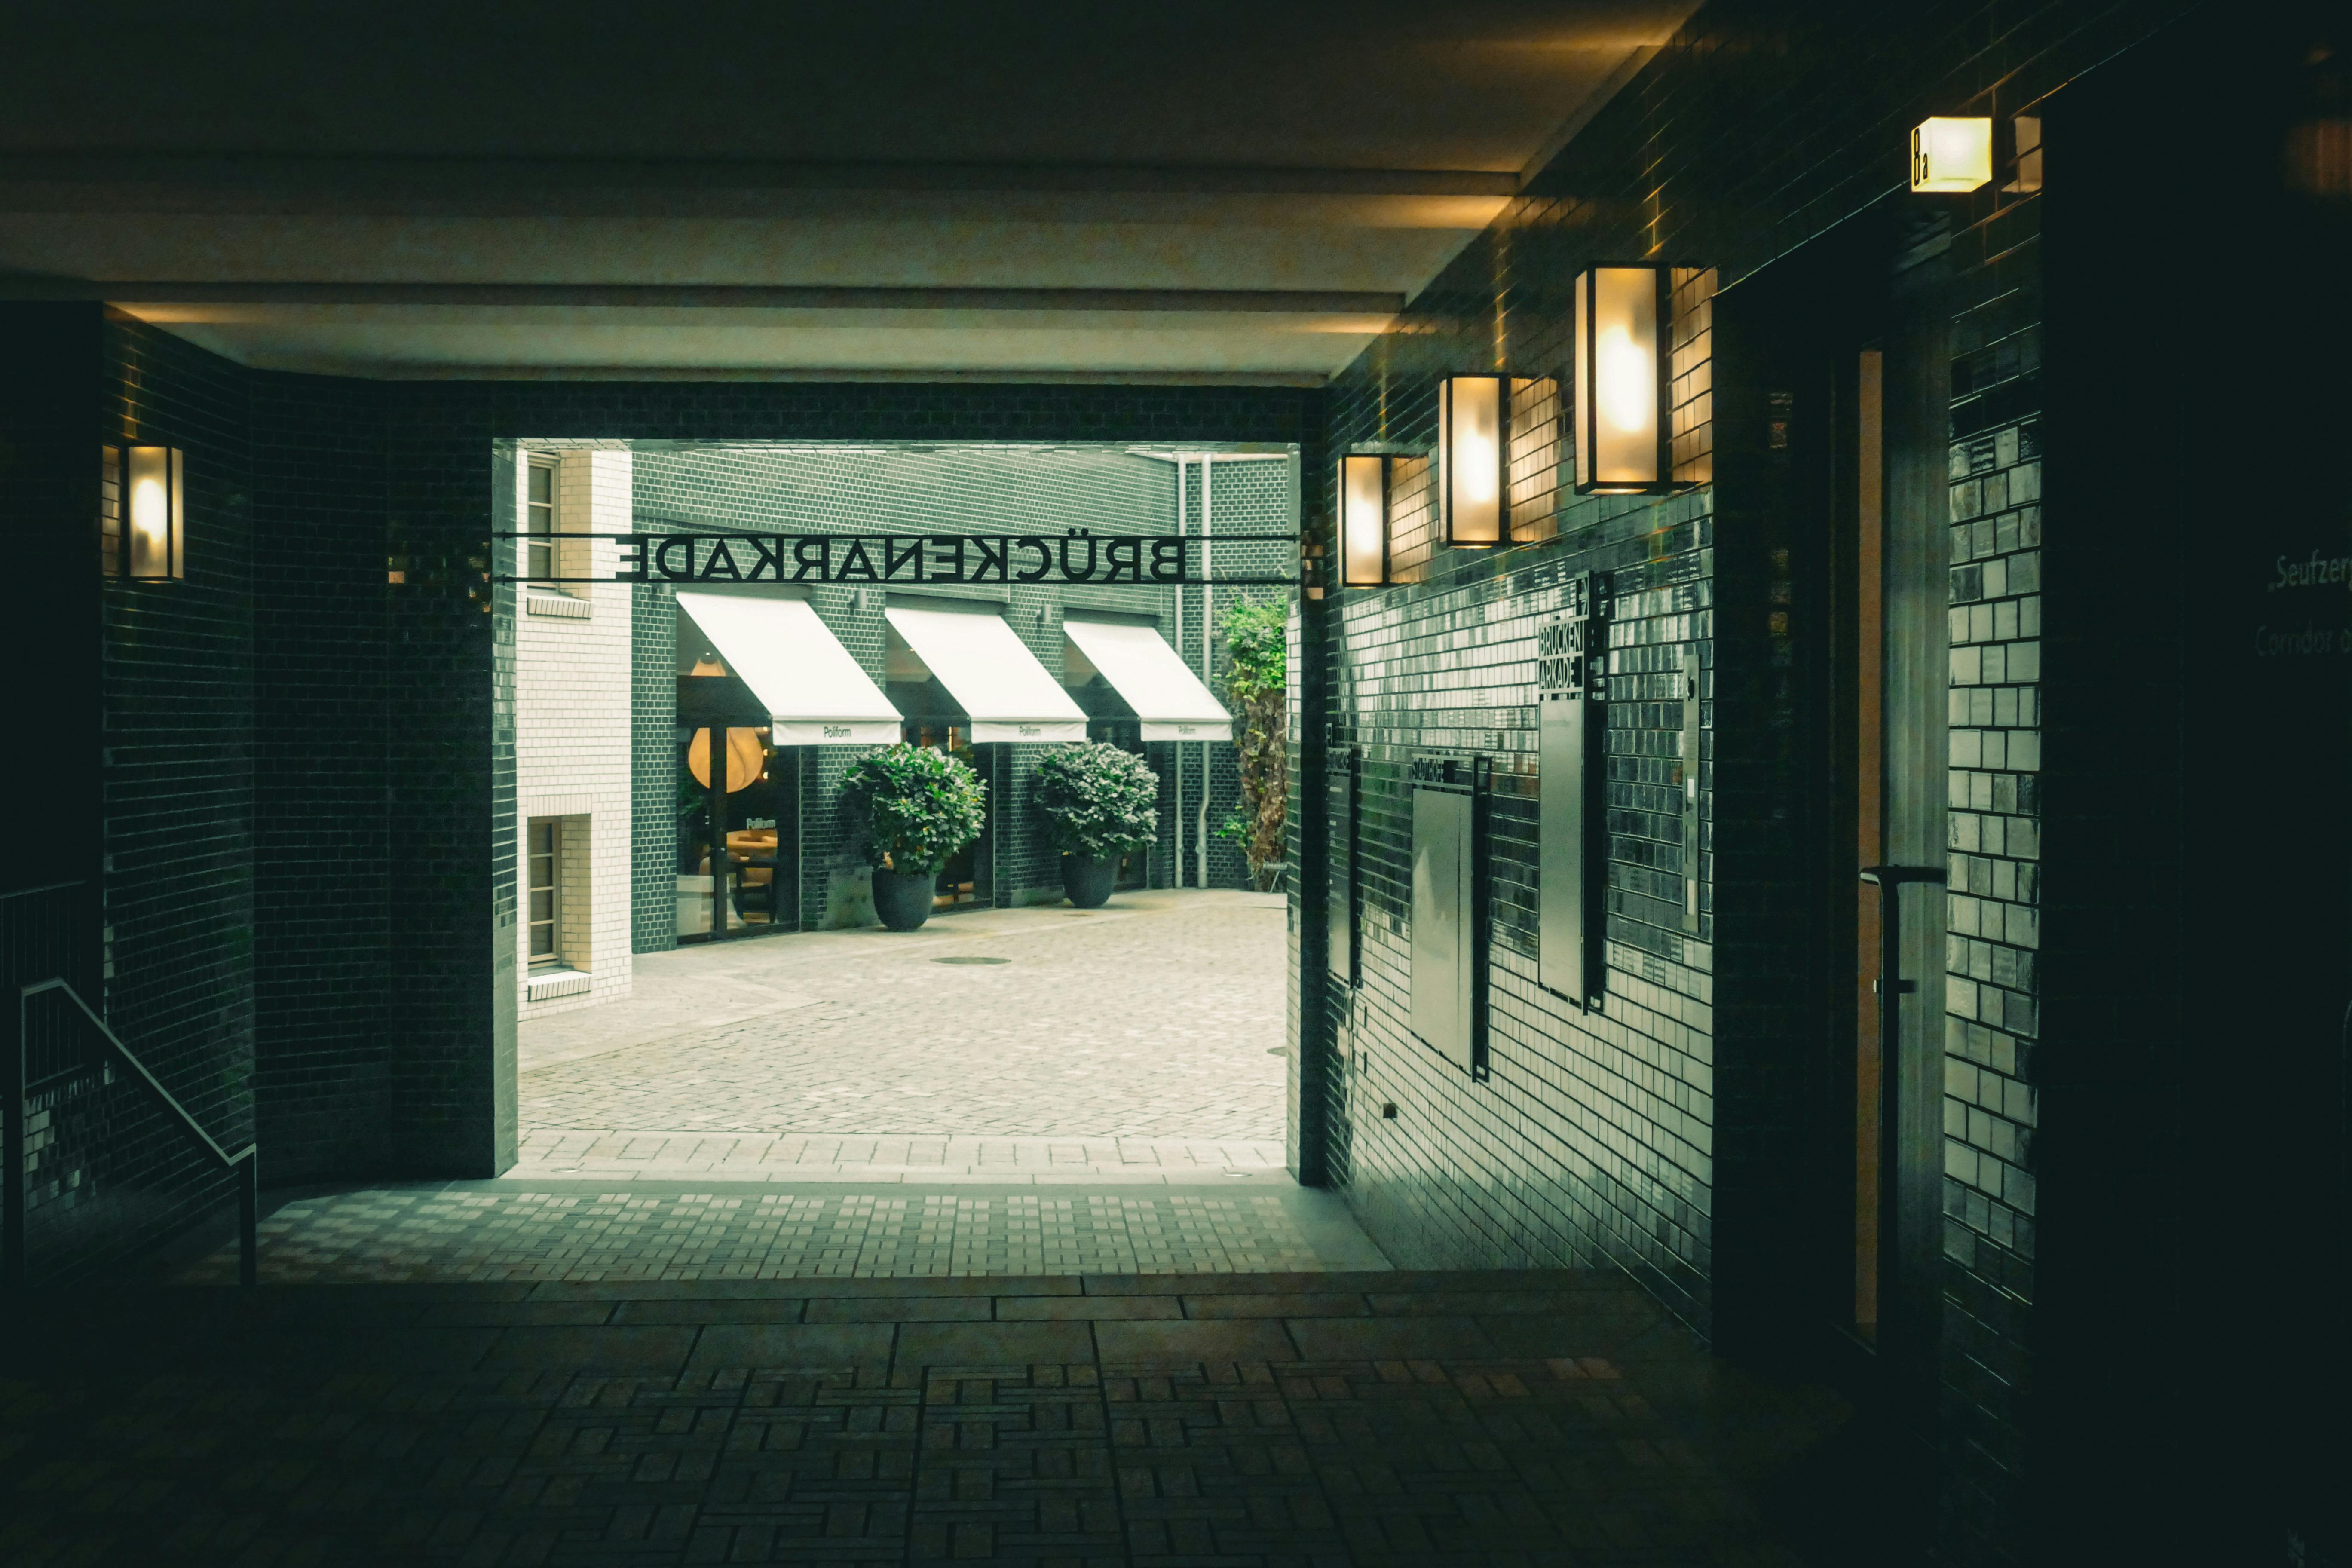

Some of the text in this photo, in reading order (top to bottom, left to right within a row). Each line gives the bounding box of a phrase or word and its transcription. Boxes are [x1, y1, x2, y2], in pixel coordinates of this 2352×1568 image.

[1914, 128, 1928, 186] 8a
[2267, 549, 2352, 592] „Seufzer
[2256, 619, 2334, 657] Corridor
[1540, 656, 1575, 690] ARKADE
[824, 726, 851, 738] Poliform
